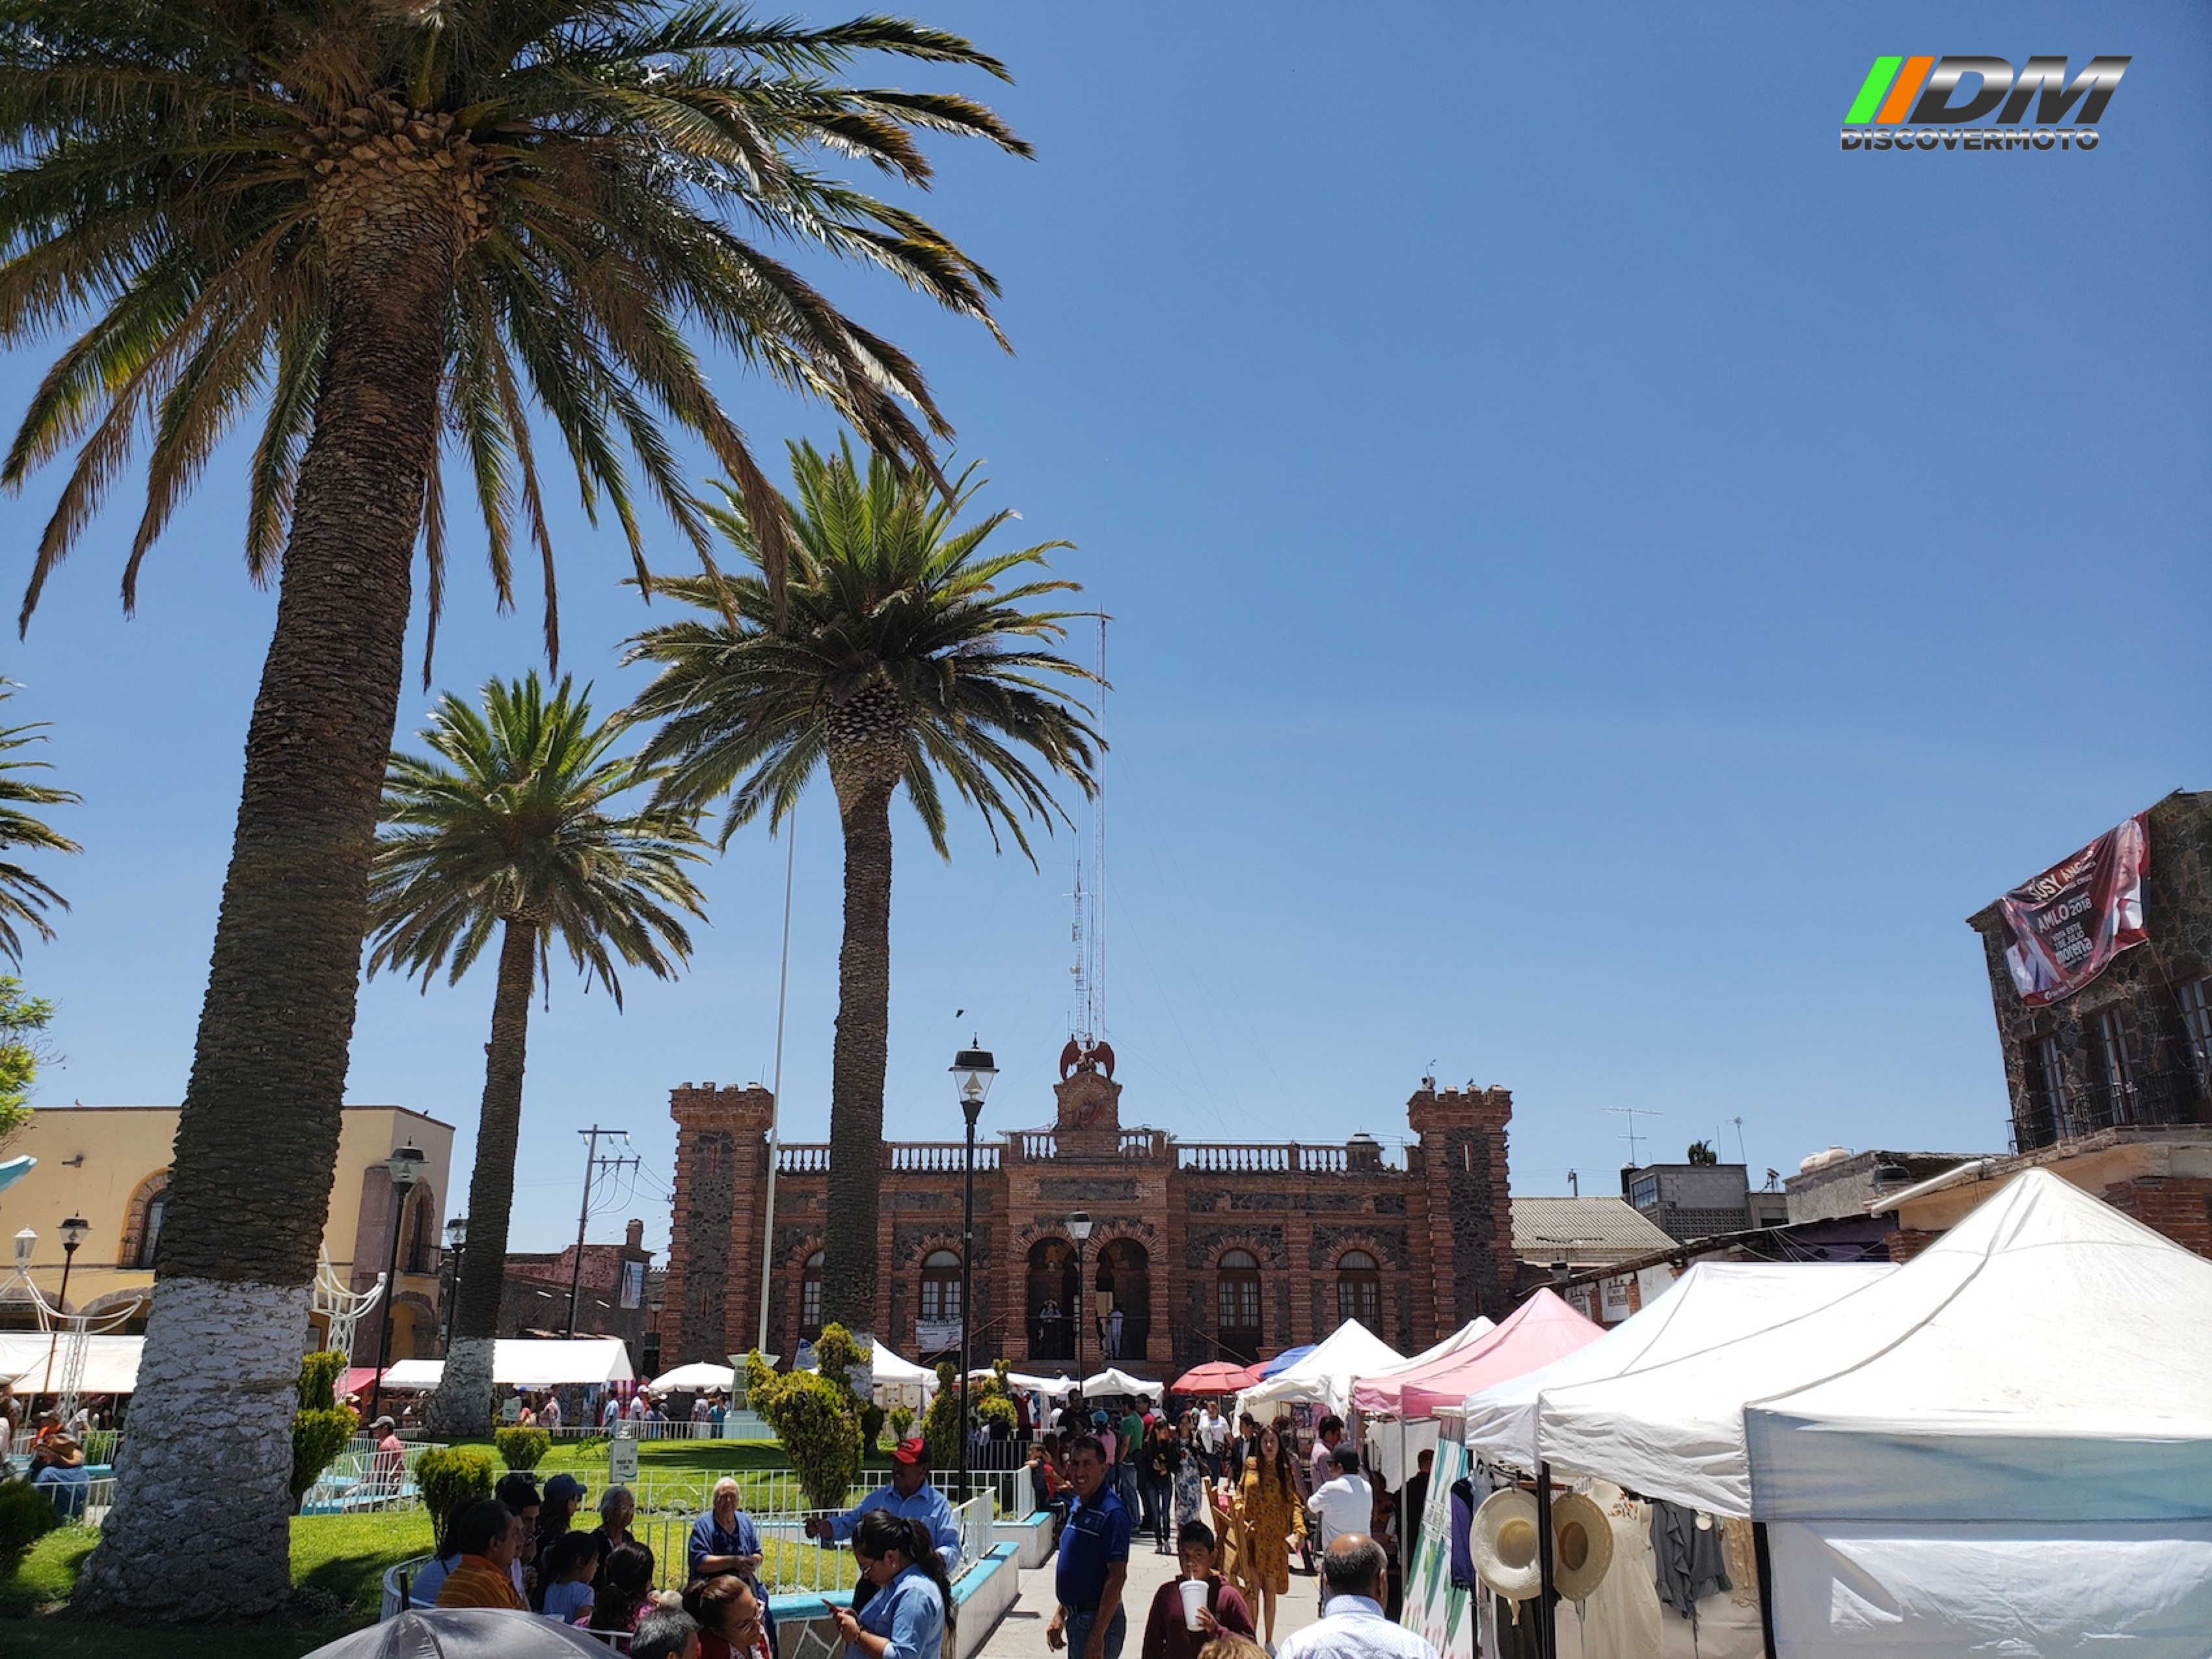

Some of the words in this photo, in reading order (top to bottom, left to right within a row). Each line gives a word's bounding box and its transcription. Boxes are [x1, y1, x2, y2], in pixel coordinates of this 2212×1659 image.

[2029, 874, 2062, 901] SUSY
[2037, 904, 2069, 933] AMLO
[2070, 897, 2092, 917] 2018
[2055, 937, 2093, 965] morena
